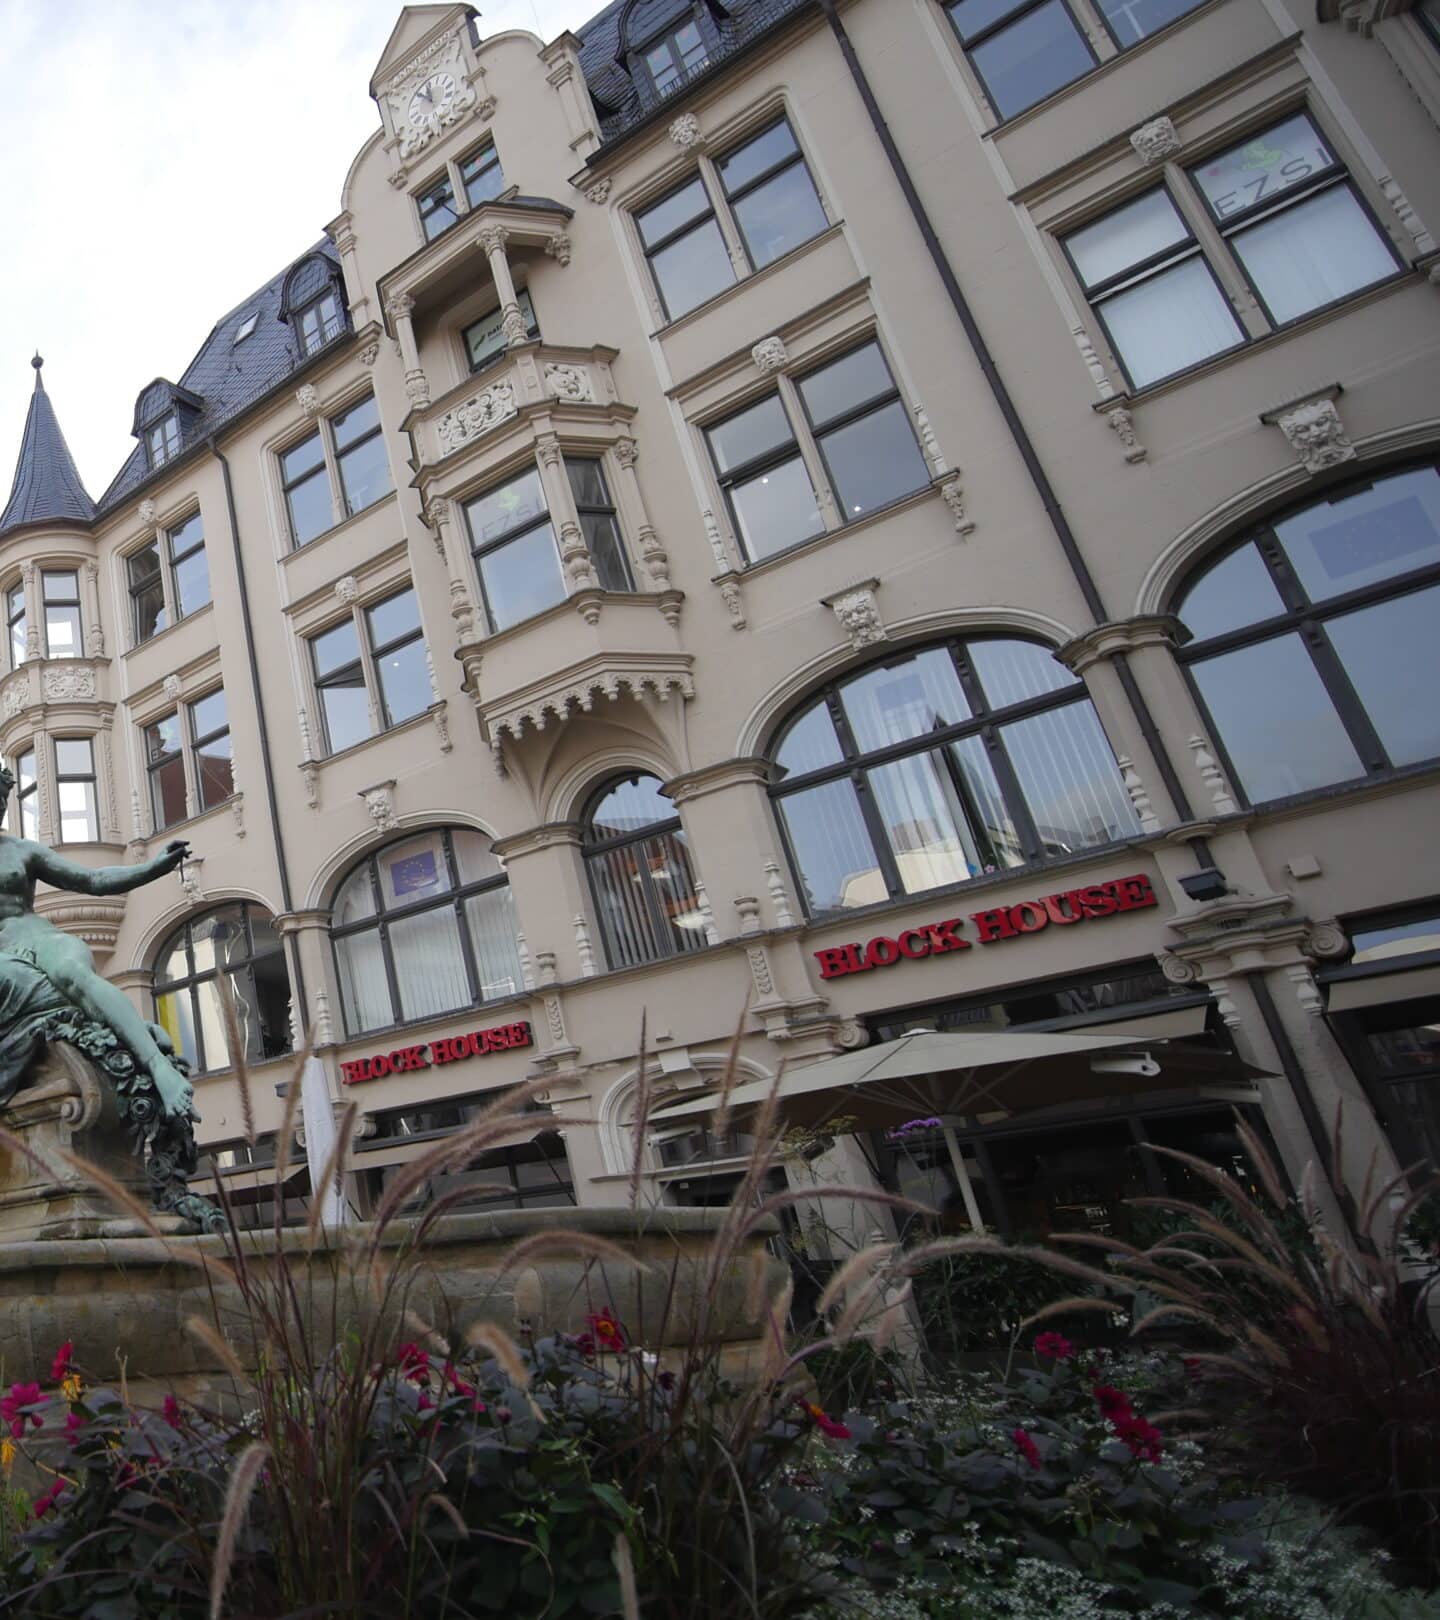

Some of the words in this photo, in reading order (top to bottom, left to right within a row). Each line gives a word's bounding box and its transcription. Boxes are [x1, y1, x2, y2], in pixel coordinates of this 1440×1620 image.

[814, 918, 972, 979] BLOCK
[969, 873, 1158, 944] HOUSE
[340, 1045, 429, 1085] BLOCK
[428, 1021, 533, 1065] HOUSE
